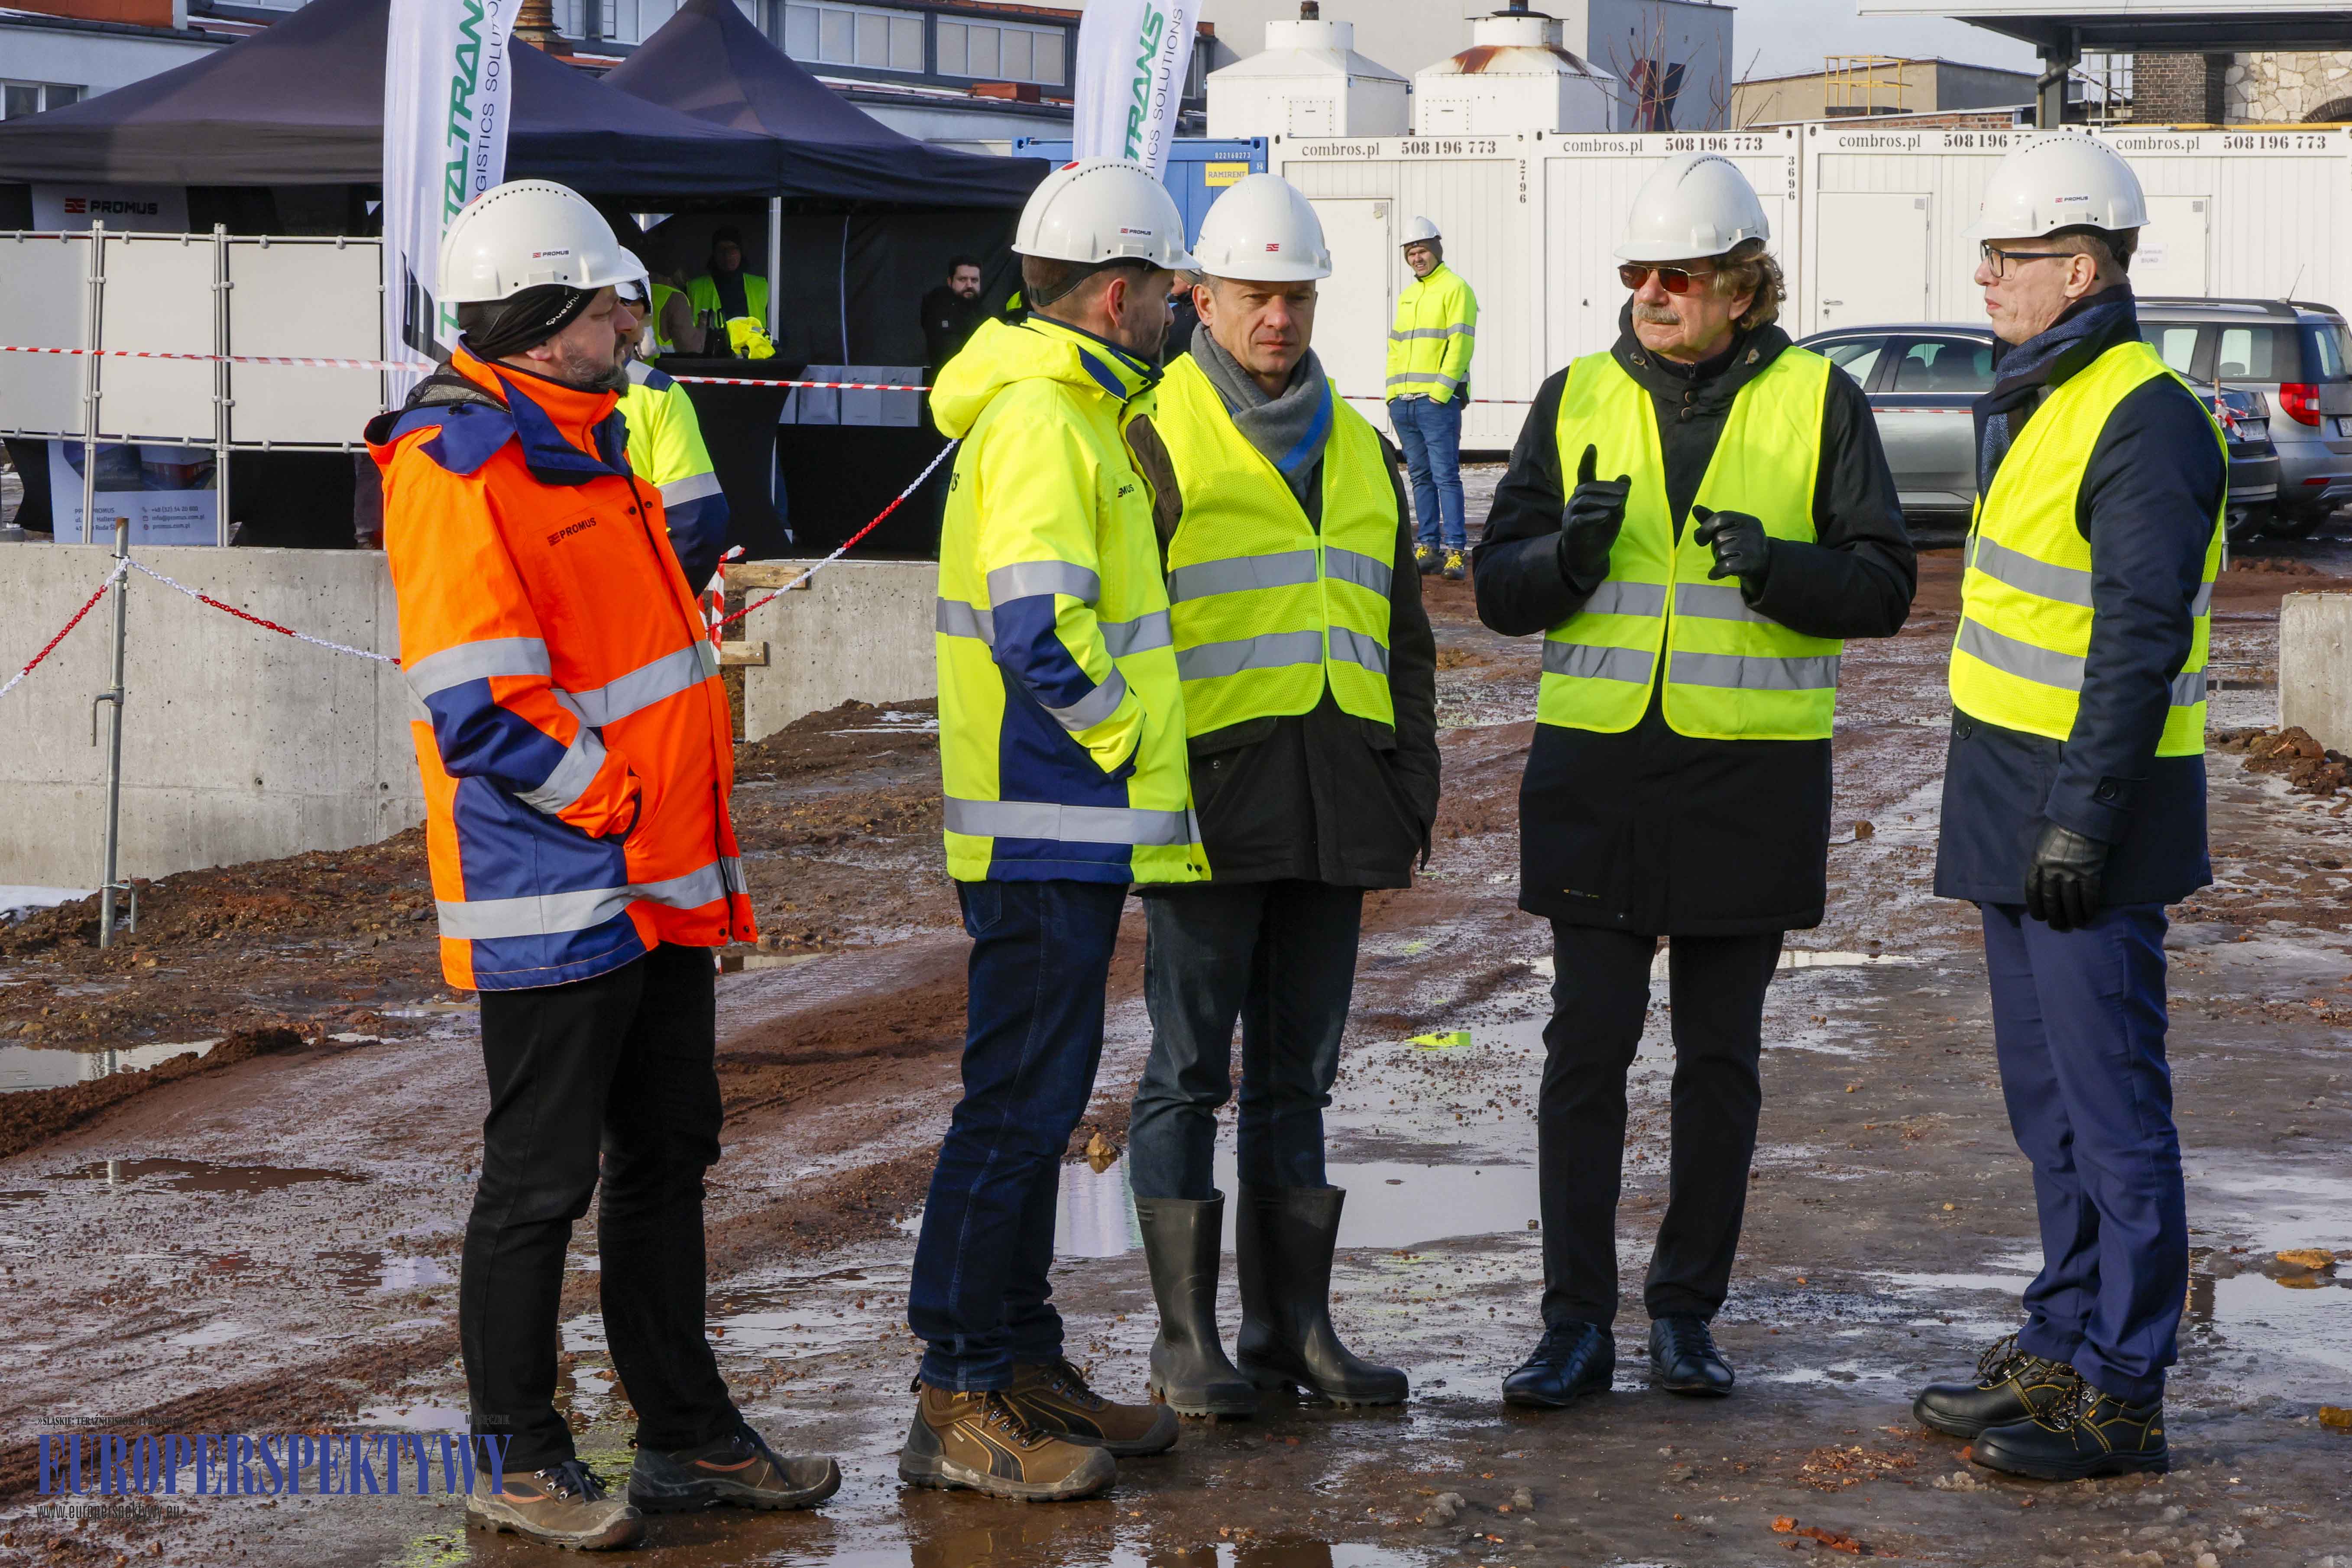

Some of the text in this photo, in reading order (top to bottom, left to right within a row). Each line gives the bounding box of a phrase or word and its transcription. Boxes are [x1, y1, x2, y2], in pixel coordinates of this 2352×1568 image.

[1153, 7, 1183, 120] SOLUTIONS
[1302, 140, 1497, 159] combros.pl 508 196 773
[1563, 137, 1763, 155] combros.pl 508 196 773
[1839, 134, 1921, 151] combros.pl
[1944, 134, 1973, 148] 508
[1979, 134, 2008, 147] 196
[2116, 136, 2326, 152] combros.pl 508 196 773
[90, 200, 158, 215] PROMUS
[546, 289, 583, 326] Quechu
[559, 517, 596, 539] PROMUS
